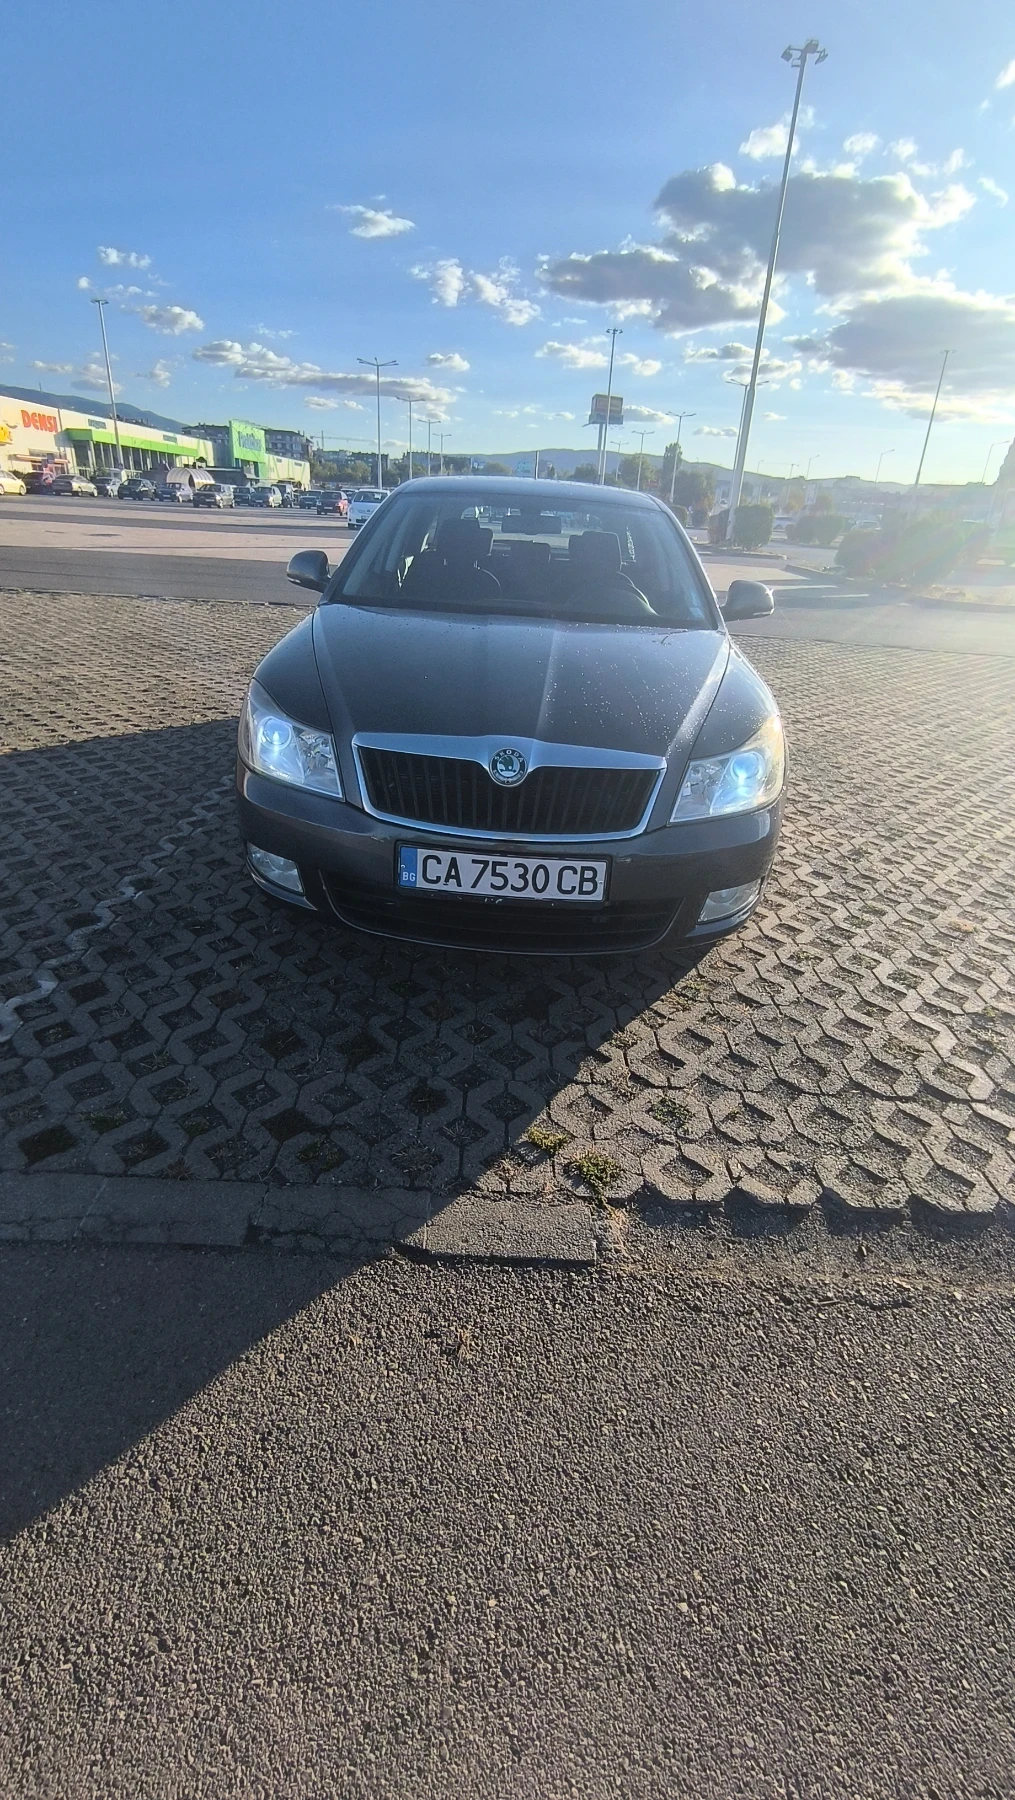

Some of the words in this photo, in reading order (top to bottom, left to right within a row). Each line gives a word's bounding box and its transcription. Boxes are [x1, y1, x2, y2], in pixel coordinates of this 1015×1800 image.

[21, 410, 58, 433] DENSI
[402, 871, 416, 882] BG
[422, 855, 462, 888] CA
[470, 859, 550, 894] 7530
[556, 865, 598, 896] CB
